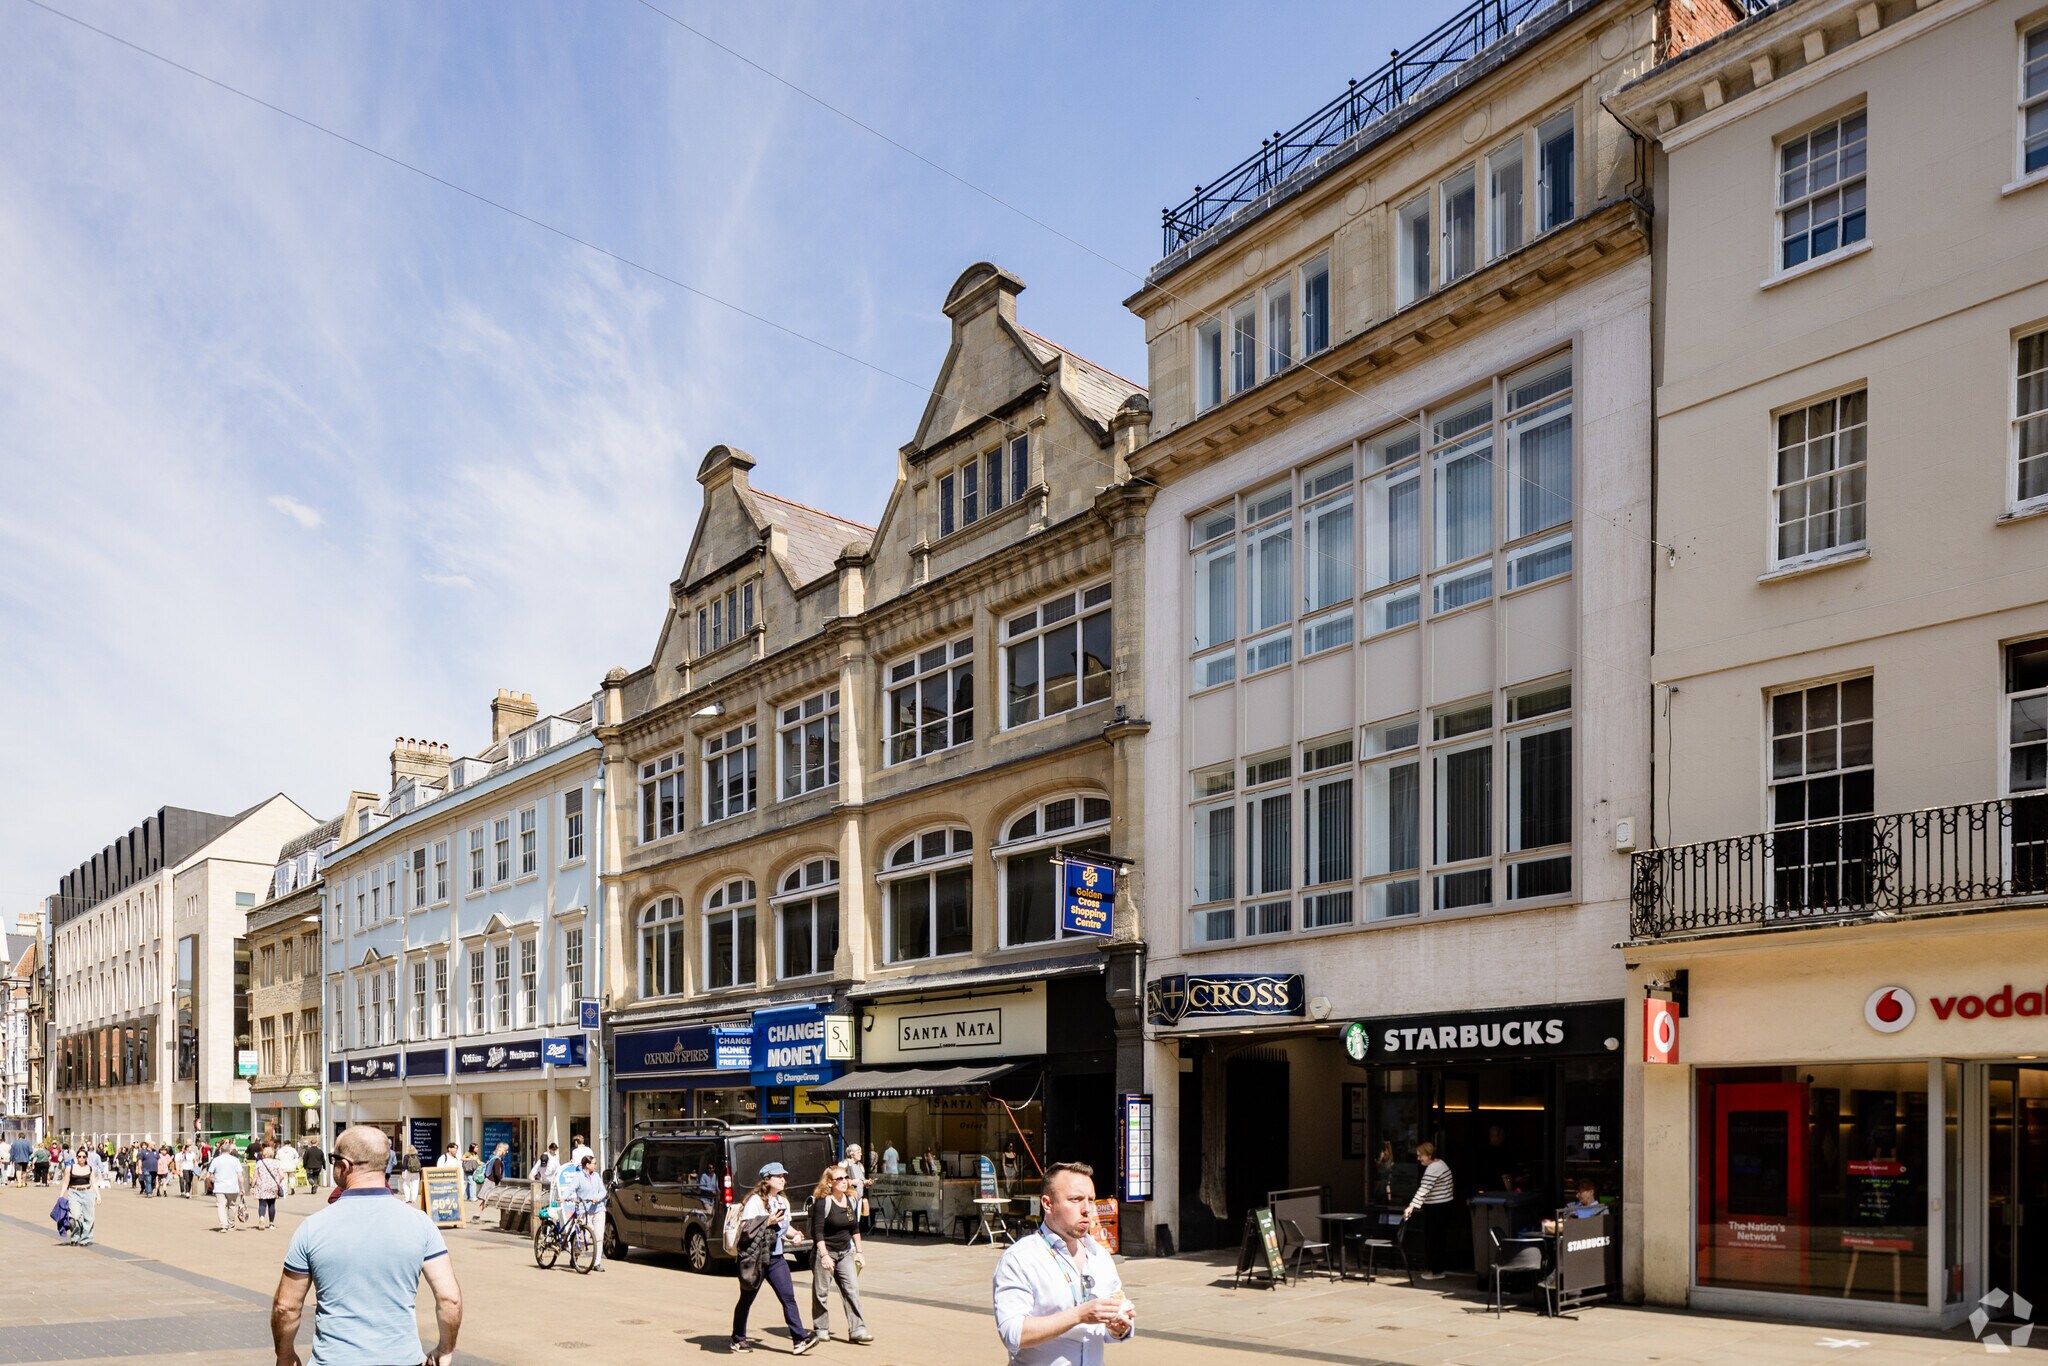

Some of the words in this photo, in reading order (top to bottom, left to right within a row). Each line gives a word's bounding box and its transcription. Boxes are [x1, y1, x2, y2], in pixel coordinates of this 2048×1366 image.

[1076, 887, 1102, 899] Golden
[1078, 897, 1100, 908] Cross
[1071, 905, 1106, 921] Shopping
[1075, 917, 1101, 929] Centre
[1190, 982, 1289, 1007] CROSS
[1929, 984, 2048, 1020] voda
[768, 1021, 824, 1043] CHANGE
[904, 1026, 948, 1041] SANTA
[956, 1021, 995, 1038] NATA
[1384, 1019, 1564, 1052] STARBUCKS
[718, 1037, 752, 1045] CHANGE
[718, 1046, 752, 1055] MONEY
[767, 1044, 824, 1068] MONEY
[644, 1051, 676, 1066] OXFORD
[681, 1048, 709, 1063] SPIRES
[784, 1072, 820, 1083] ChangeGroup
[877, 1089, 901, 1097] PASTEL
[432, 1198, 458, 1209] 50%
[1728, 1221, 1746, 1230] The
[1747, 1222, 1786, 1232] Nation's
[1737, 1231, 1777, 1241] Network
[1567, 1236, 1611, 1252] STARBUCKS
